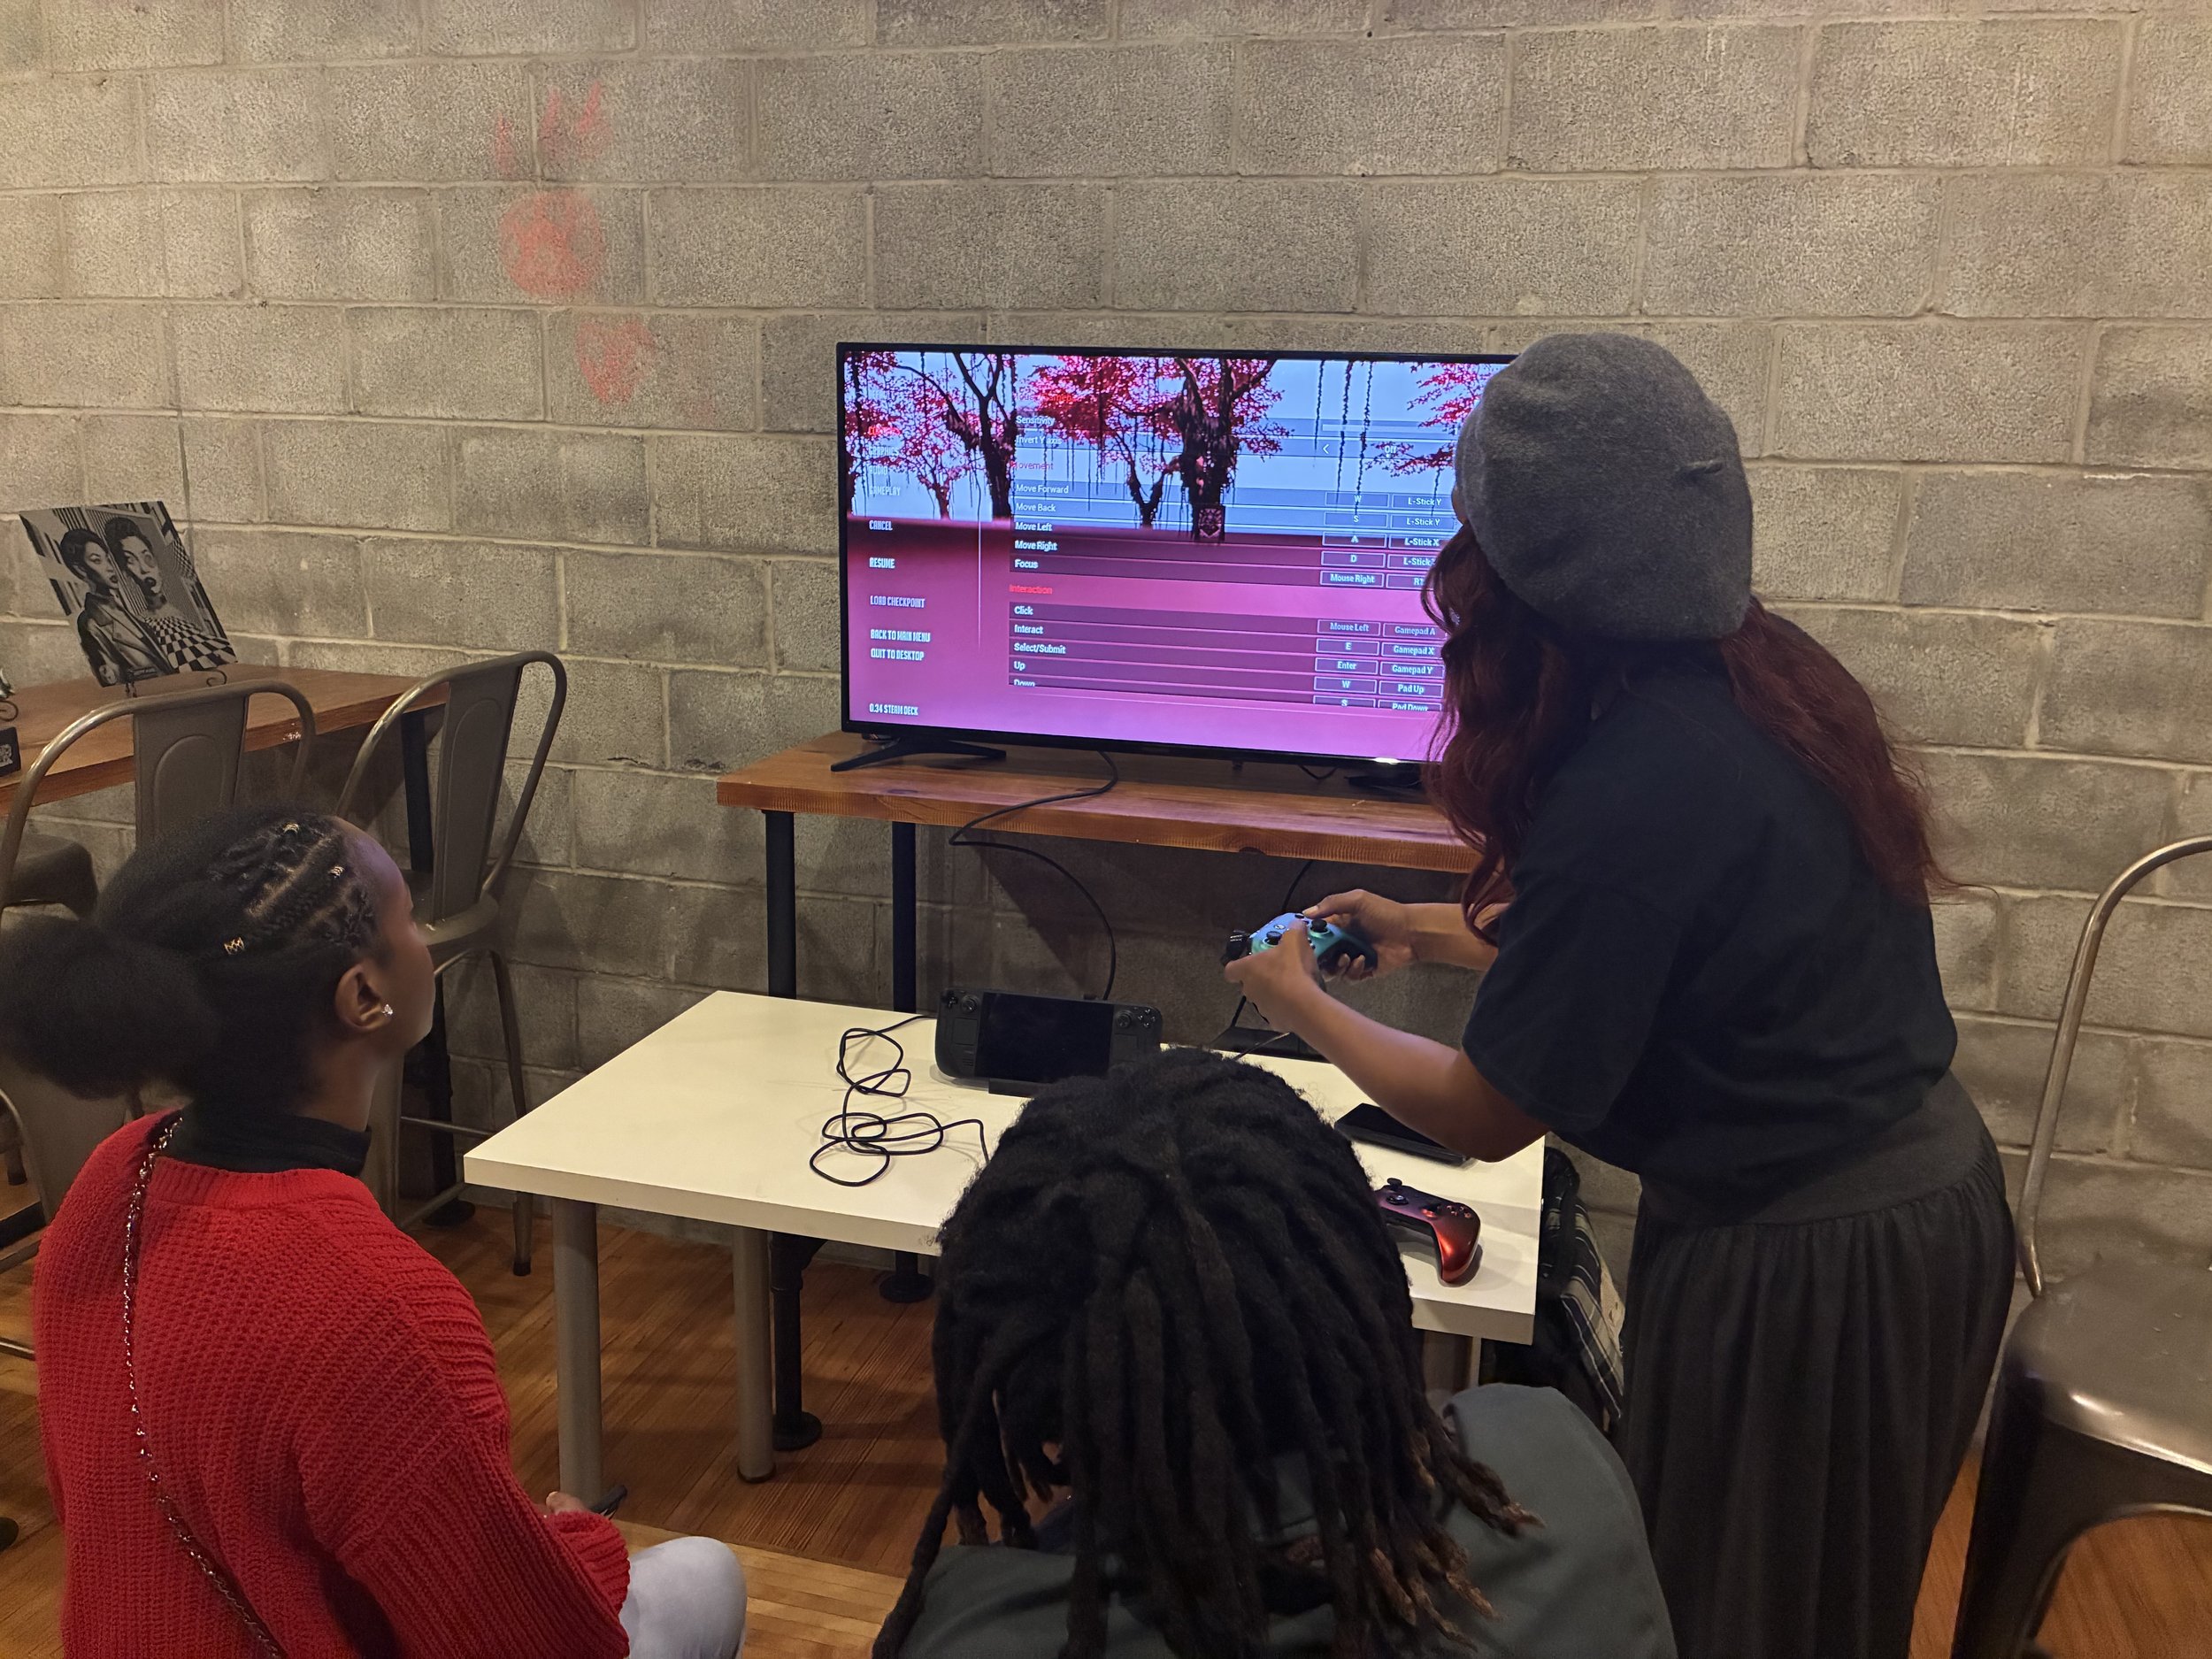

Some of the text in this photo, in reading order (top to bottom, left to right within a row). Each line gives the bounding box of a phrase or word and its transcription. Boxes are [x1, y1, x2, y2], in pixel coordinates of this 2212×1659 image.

[1016, 484, 1070, 494] Move Forward
[1016, 503, 1036, 511] Move
[870, 520, 893, 531] CANCEL
[1015, 522, 1053, 532] Move Left
[1015, 541, 1058, 552] Move Right
[870, 557, 895, 569] RESUME
[1015, 559, 1039, 569] Focus
[1330, 573, 1376, 585] Mouse Right
[1009, 584, 1053, 595] Interaction
[870, 595, 926, 609] LOAD CHECKPOINT
[1014, 606, 1033, 616] Click
[1014, 625, 1044, 634] Interact
[1330, 622, 1354, 632] Mouse
[1394, 626, 1428, 636] Gamepad
[870, 629, 932, 643] BACK TO MAIN MENU
[1014, 643, 1066, 655] Select/Submit
[1394, 645, 1428, 656] Gamepad
[871, 649, 925, 662] QUIT TO DESKTOP
[1014, 661, 1026, 672] Up
[1338, 661, 1357, 670] Enter
[1392, 664, 1426, 675] Gamepad
[1341, 680, 1351, 689] W
[1398, 684, 1425, 695] Pad Up
[870, 703, 919, 716] 0.34 STEAM DECK
